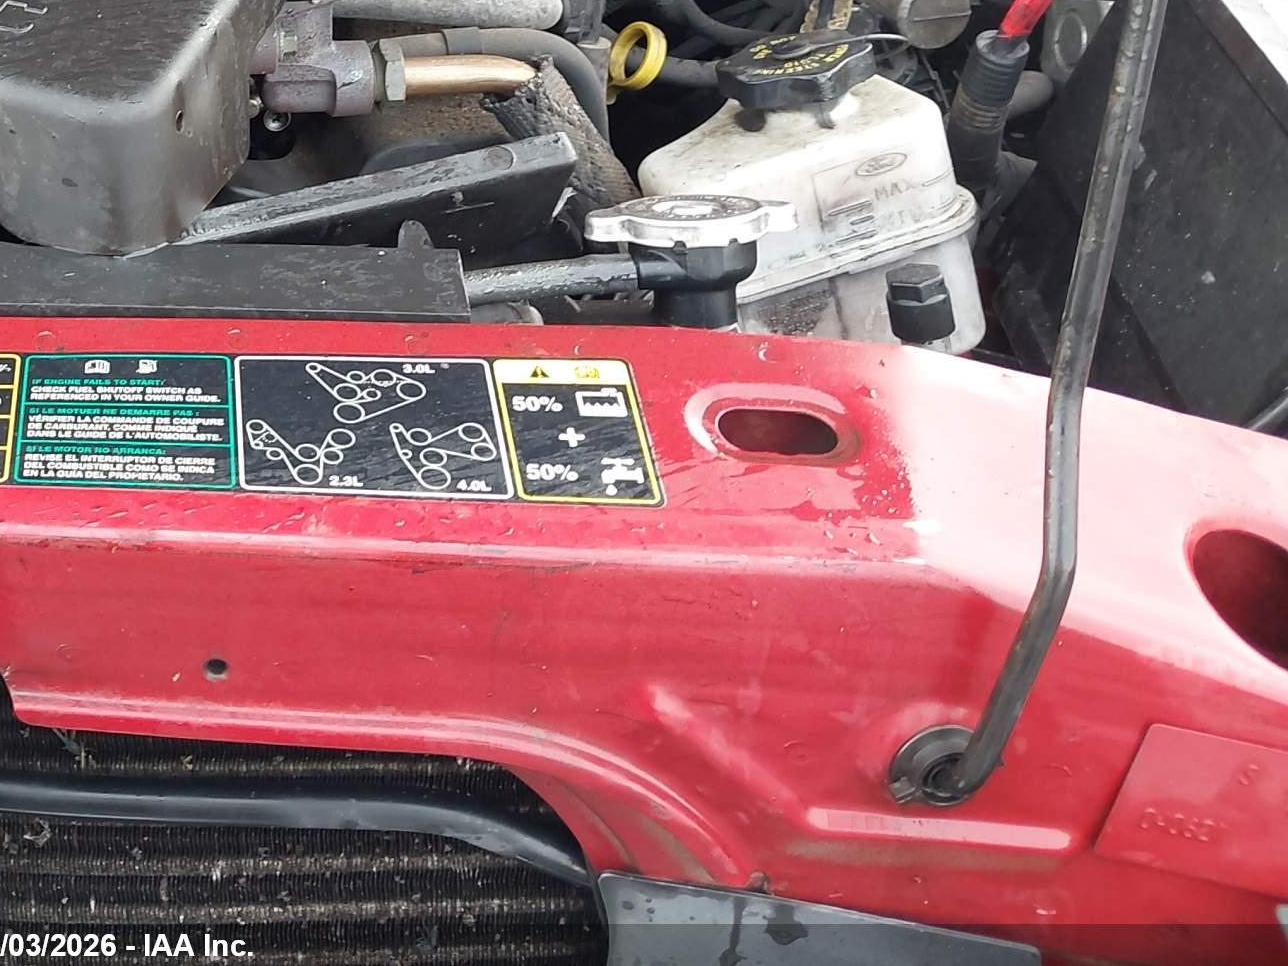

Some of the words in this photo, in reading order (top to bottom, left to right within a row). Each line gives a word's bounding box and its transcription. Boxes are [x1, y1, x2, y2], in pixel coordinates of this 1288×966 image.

[402, 363, 436, 374] 3.0L
[96, 386, 144, 394] SHUTOFF
[30, 393, 99, 401] REFERENCED
[144, 394, 184, 402] OWNER
[185, 395, 221, 403] GUIDE.
[512, 395, 563, 412] 50%
[28, 414, 76, 422] VÉRIFIER
[77, 415, 92, 423] LA
[93, 415, 154, 424] COMMANDE
[172, 417, 225, 426] COUPURE
[44, 423, 111, 431] CARBURANT,
[26, 430, 57, 438] DANS
[58, 430, 72, 438] LE
[108, 431, 124, 439] DE
[125, 431, 223, 441] L'AUTOMOBILISTE.
[111, 446, 167, 455] ARRANCA:
[24, 453, 64, 461] REVISE
[64, 454, 79, 462] EL
[80, 455, 156, 464] INTERRUPTOR
[157, 456, 174, 464] DE
[175, 457, 216, 466] CIERRE
[23, 461, 46, 469] DEL
[46, 462, 124, 471] COMBUSTIBLE
[125, 464, 159, 472] COMO
[177, 465, 215, 474] INDICA
[526, 463, 579, 482] 50%
[22, 469, 39, 477] EN
[84, 470, 107, 479] DEL
[108, 471, 184, 481] PROPIETARIO.
[328, 475, 364, 487] 2.3L
[456, 479, 492, 492] 4.0L
